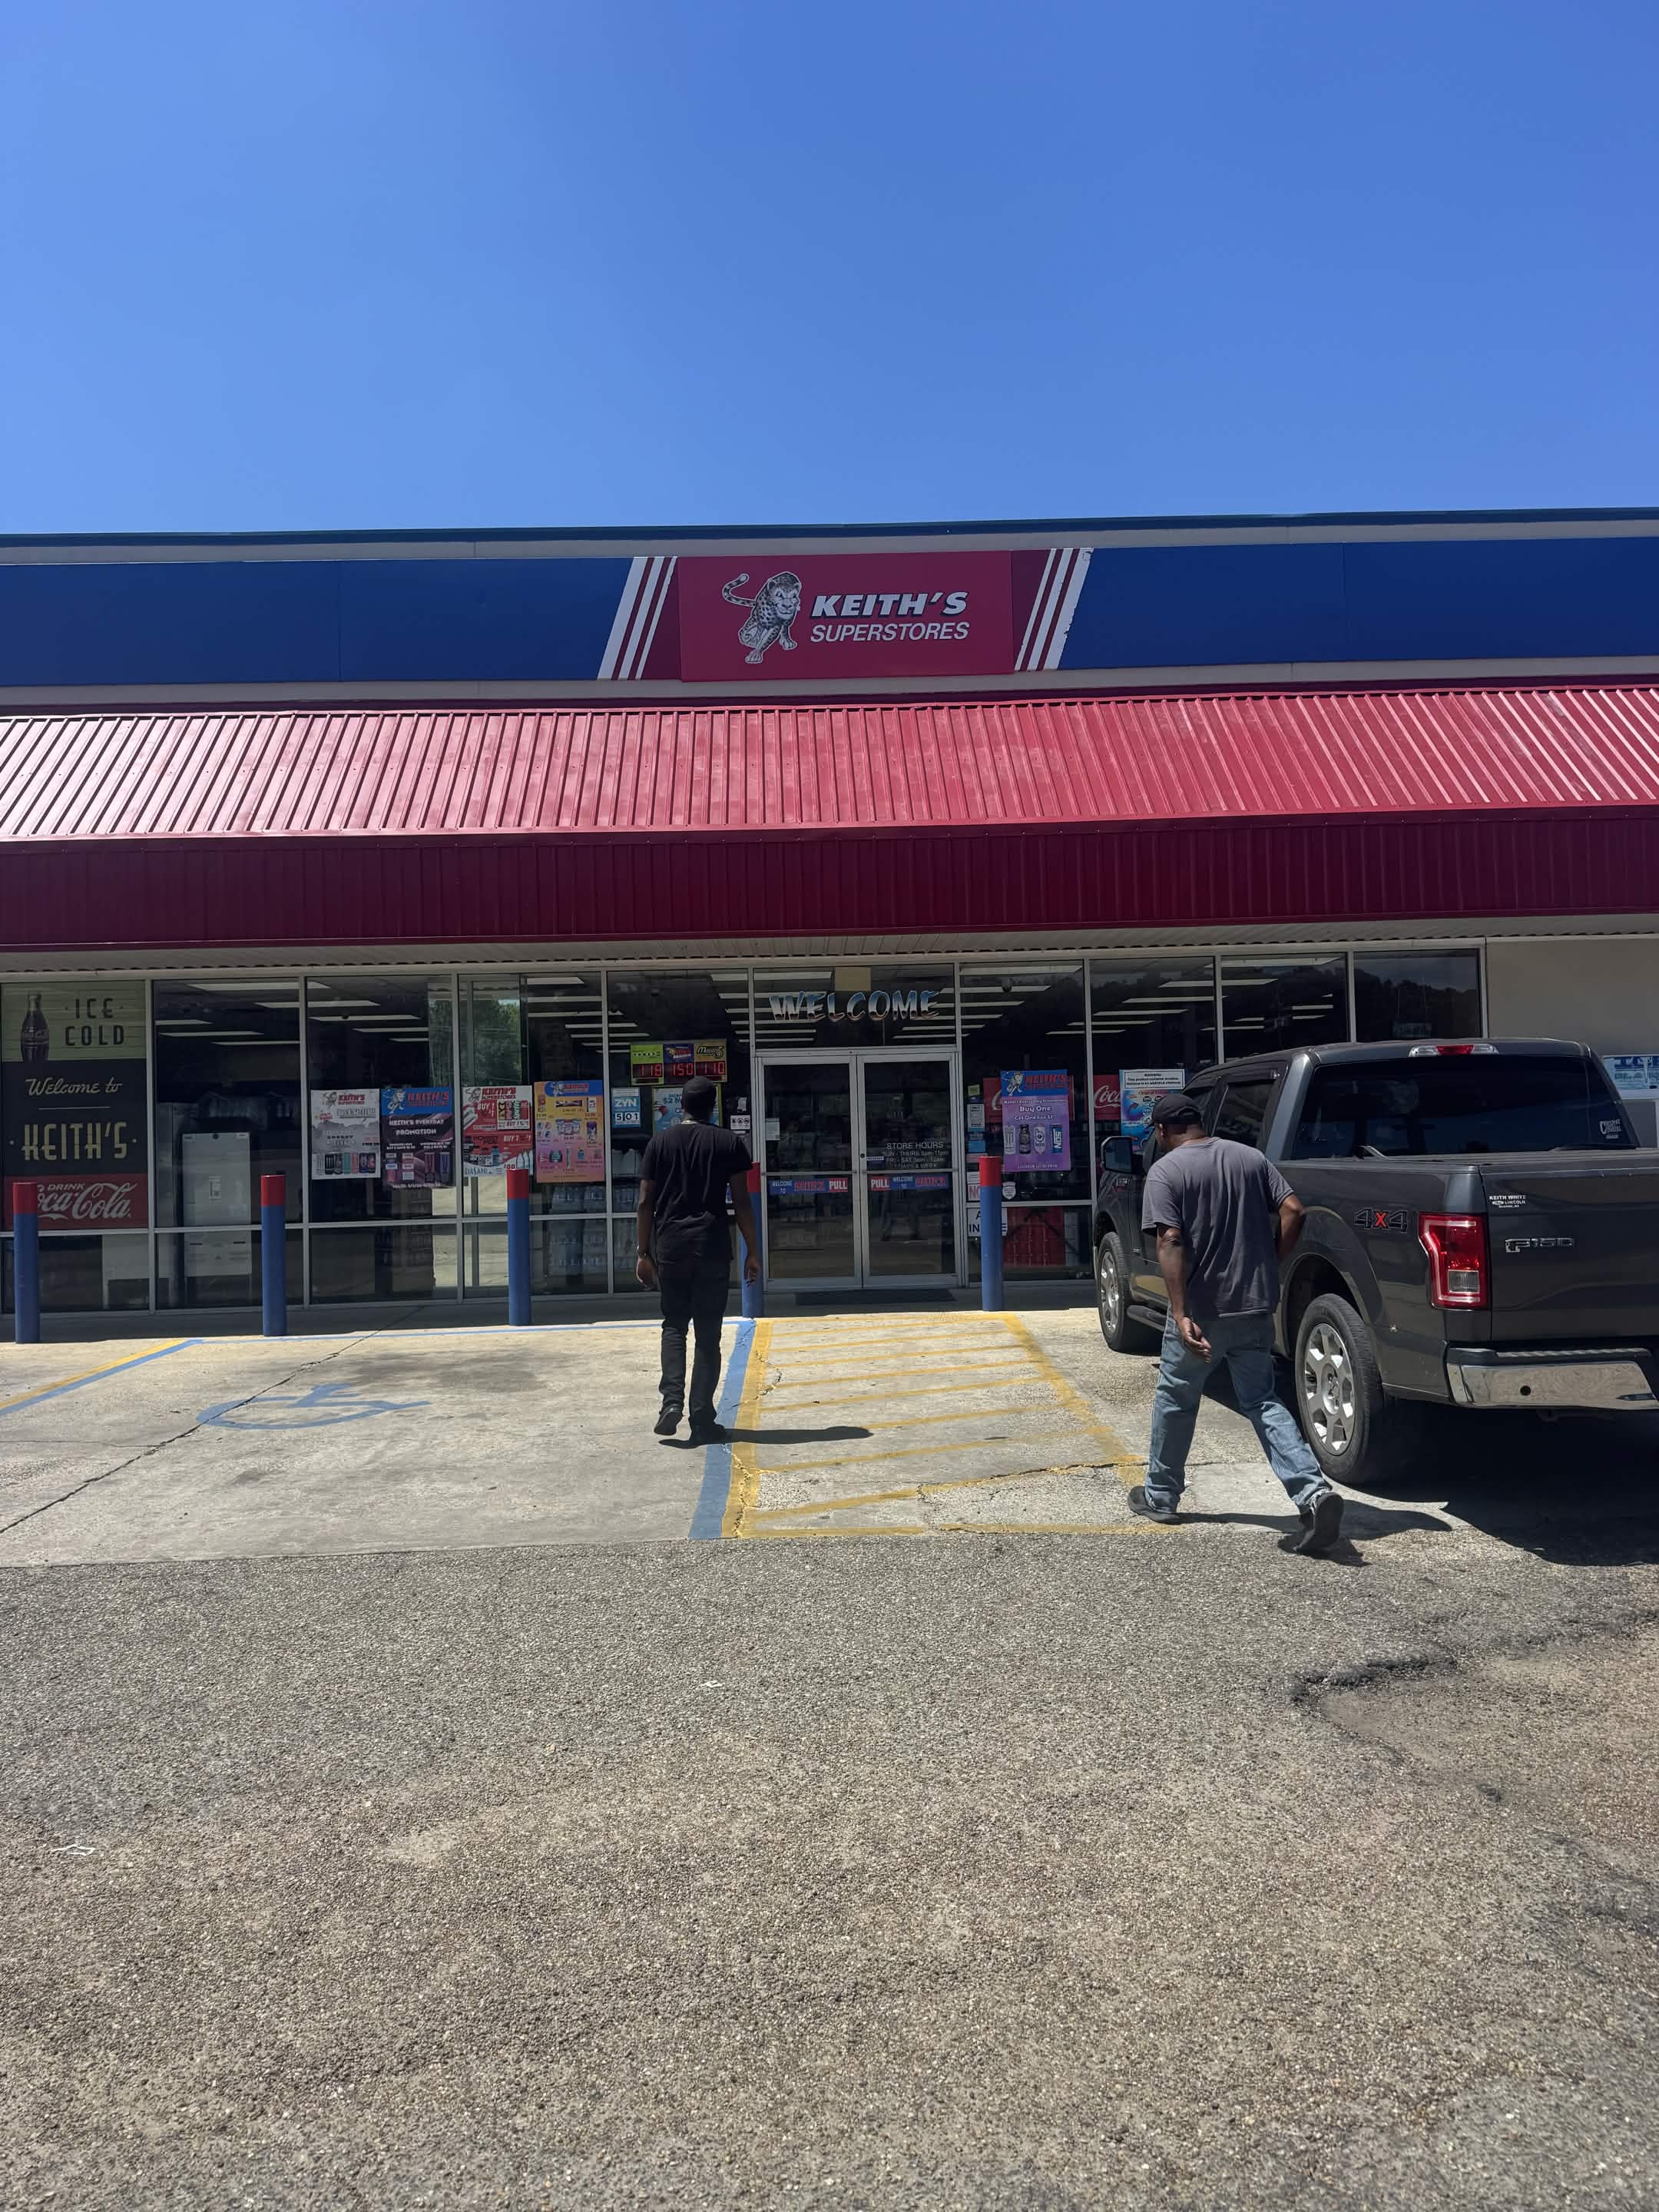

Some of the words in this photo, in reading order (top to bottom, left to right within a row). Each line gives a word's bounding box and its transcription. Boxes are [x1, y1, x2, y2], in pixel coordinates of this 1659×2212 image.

[811, 592, 968, 617] KEITH'S
[810, 622, 969, 642] SUPERSTORES
[75, 998, 114, 1019] ICE
[769, 990, 940, 1022] WELCOME
[65, 1025, 124, 1045] COLD
[673, 1063, 694, 1076] 150
[25, 1077, 101, 1095] Welcome
[105, 1076, 123, 1093] to
[614, 1098, 637, 1108] ZYN
[21, 1121, 127, 1161] KEITH'S
[829, 1180, 848, 1190] PULL
[871, 1179, 890, 1188] PULL
